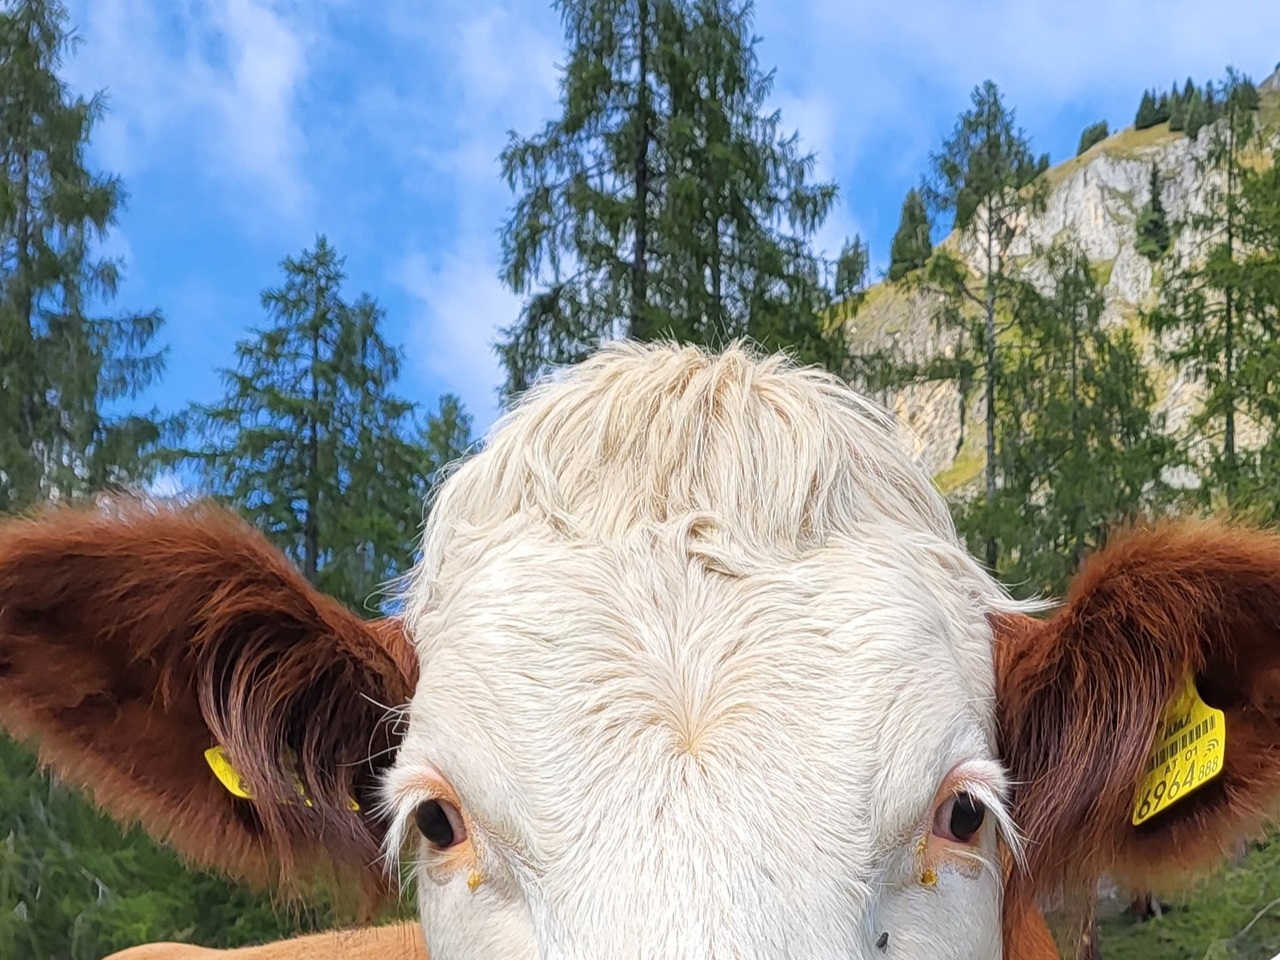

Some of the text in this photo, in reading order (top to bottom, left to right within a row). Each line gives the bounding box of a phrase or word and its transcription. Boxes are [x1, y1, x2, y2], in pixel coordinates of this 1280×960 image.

[1138, 755, 1219, 818] 6964 888
[1165, 759, 1179, 775] AT
